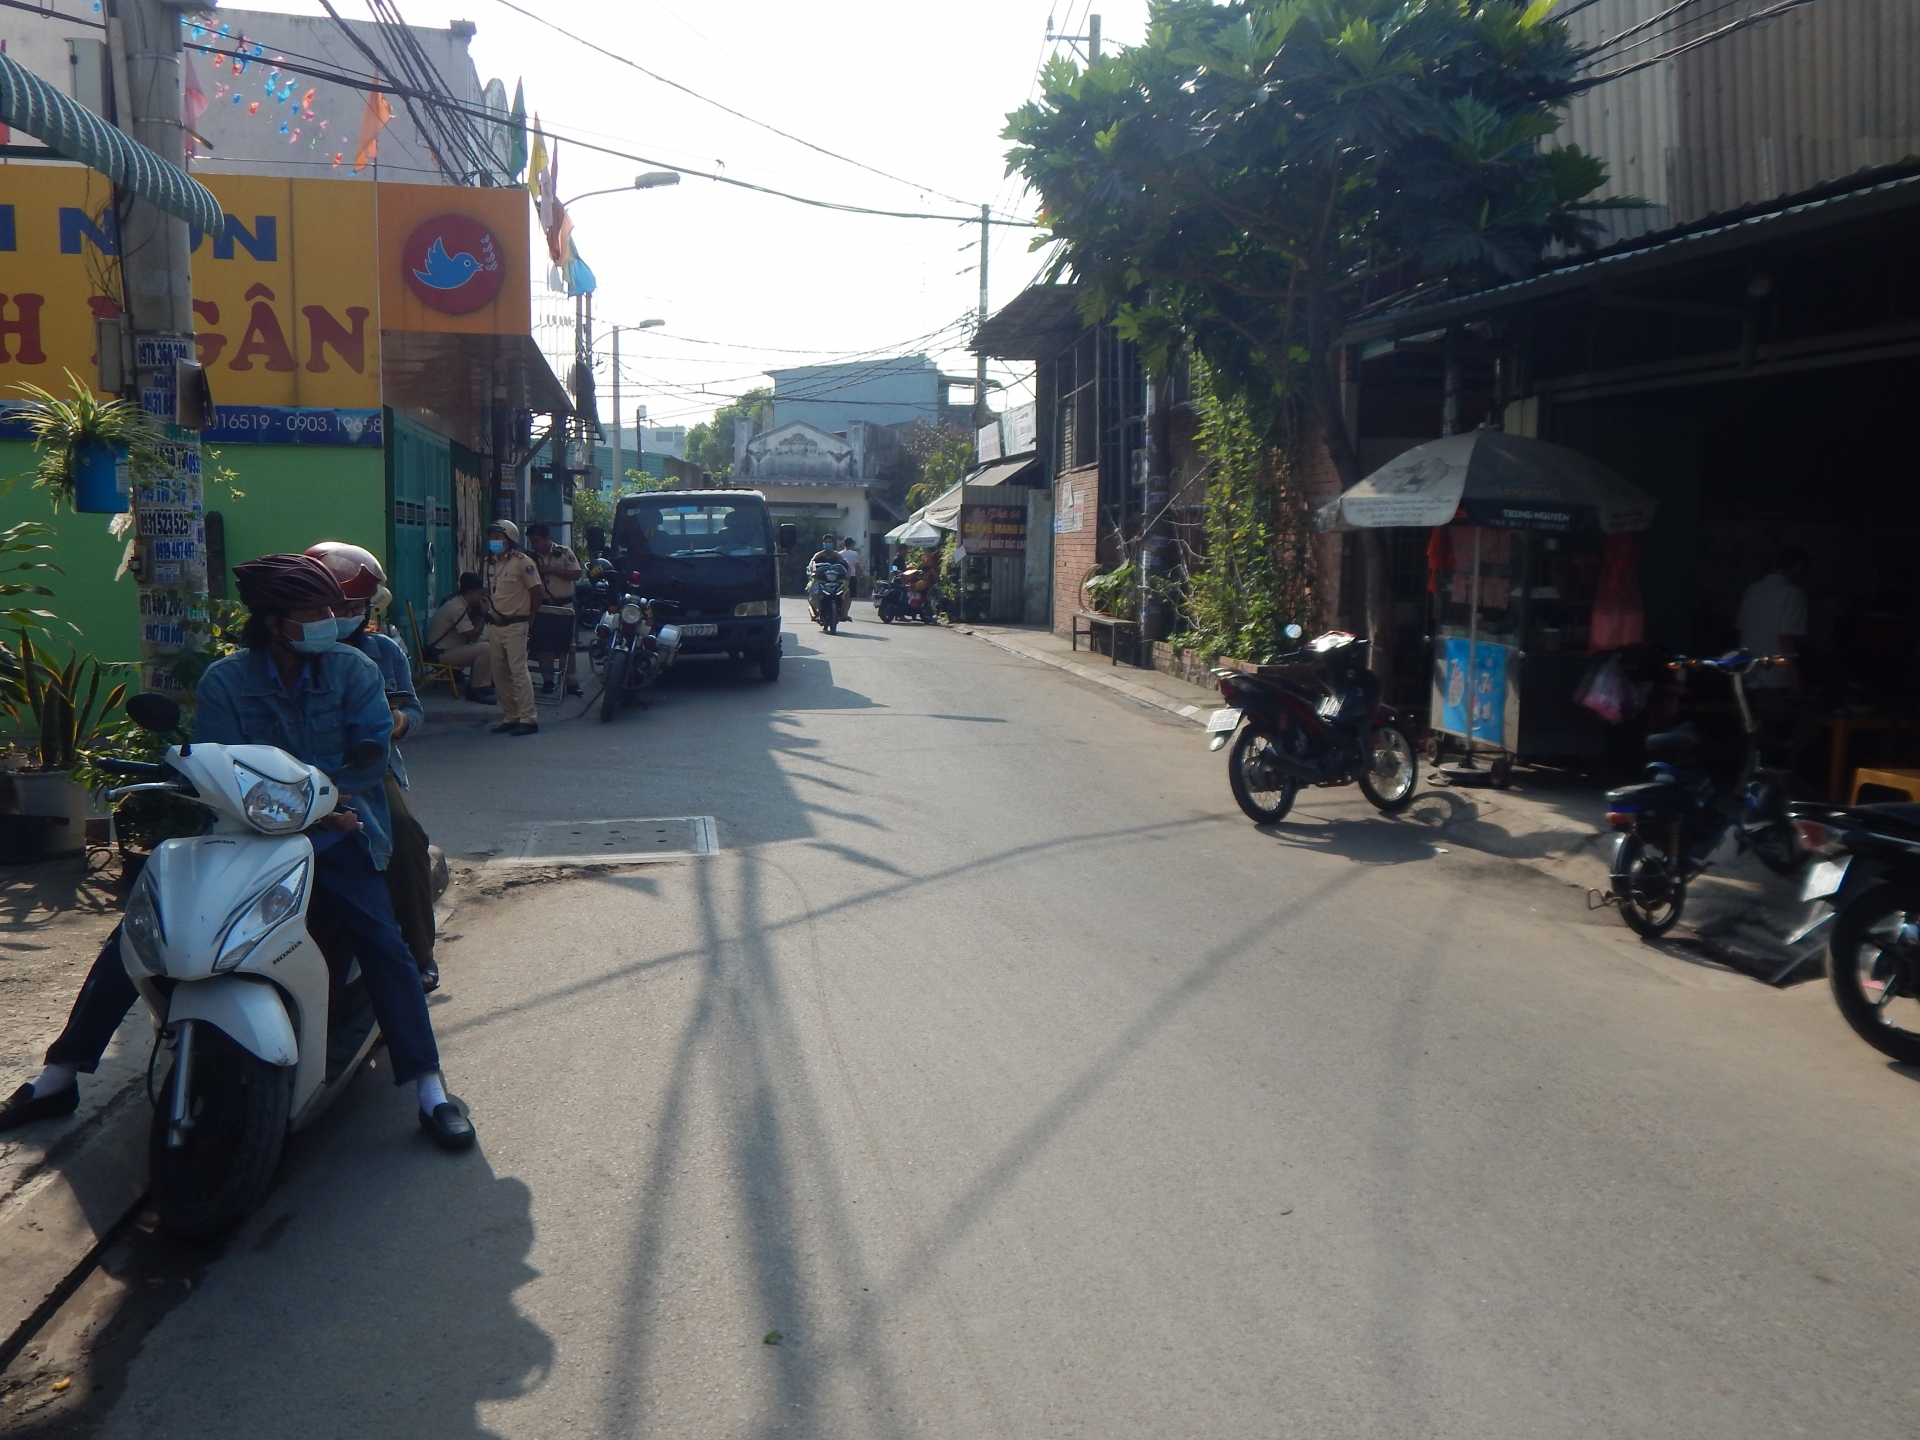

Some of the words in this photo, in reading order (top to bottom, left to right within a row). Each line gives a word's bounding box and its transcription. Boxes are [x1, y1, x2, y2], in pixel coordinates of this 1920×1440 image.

[59, 207, 278, 262] NN
[88, 282, 370, 375] GÂN
[272, 941, 303, 965] HONDA
